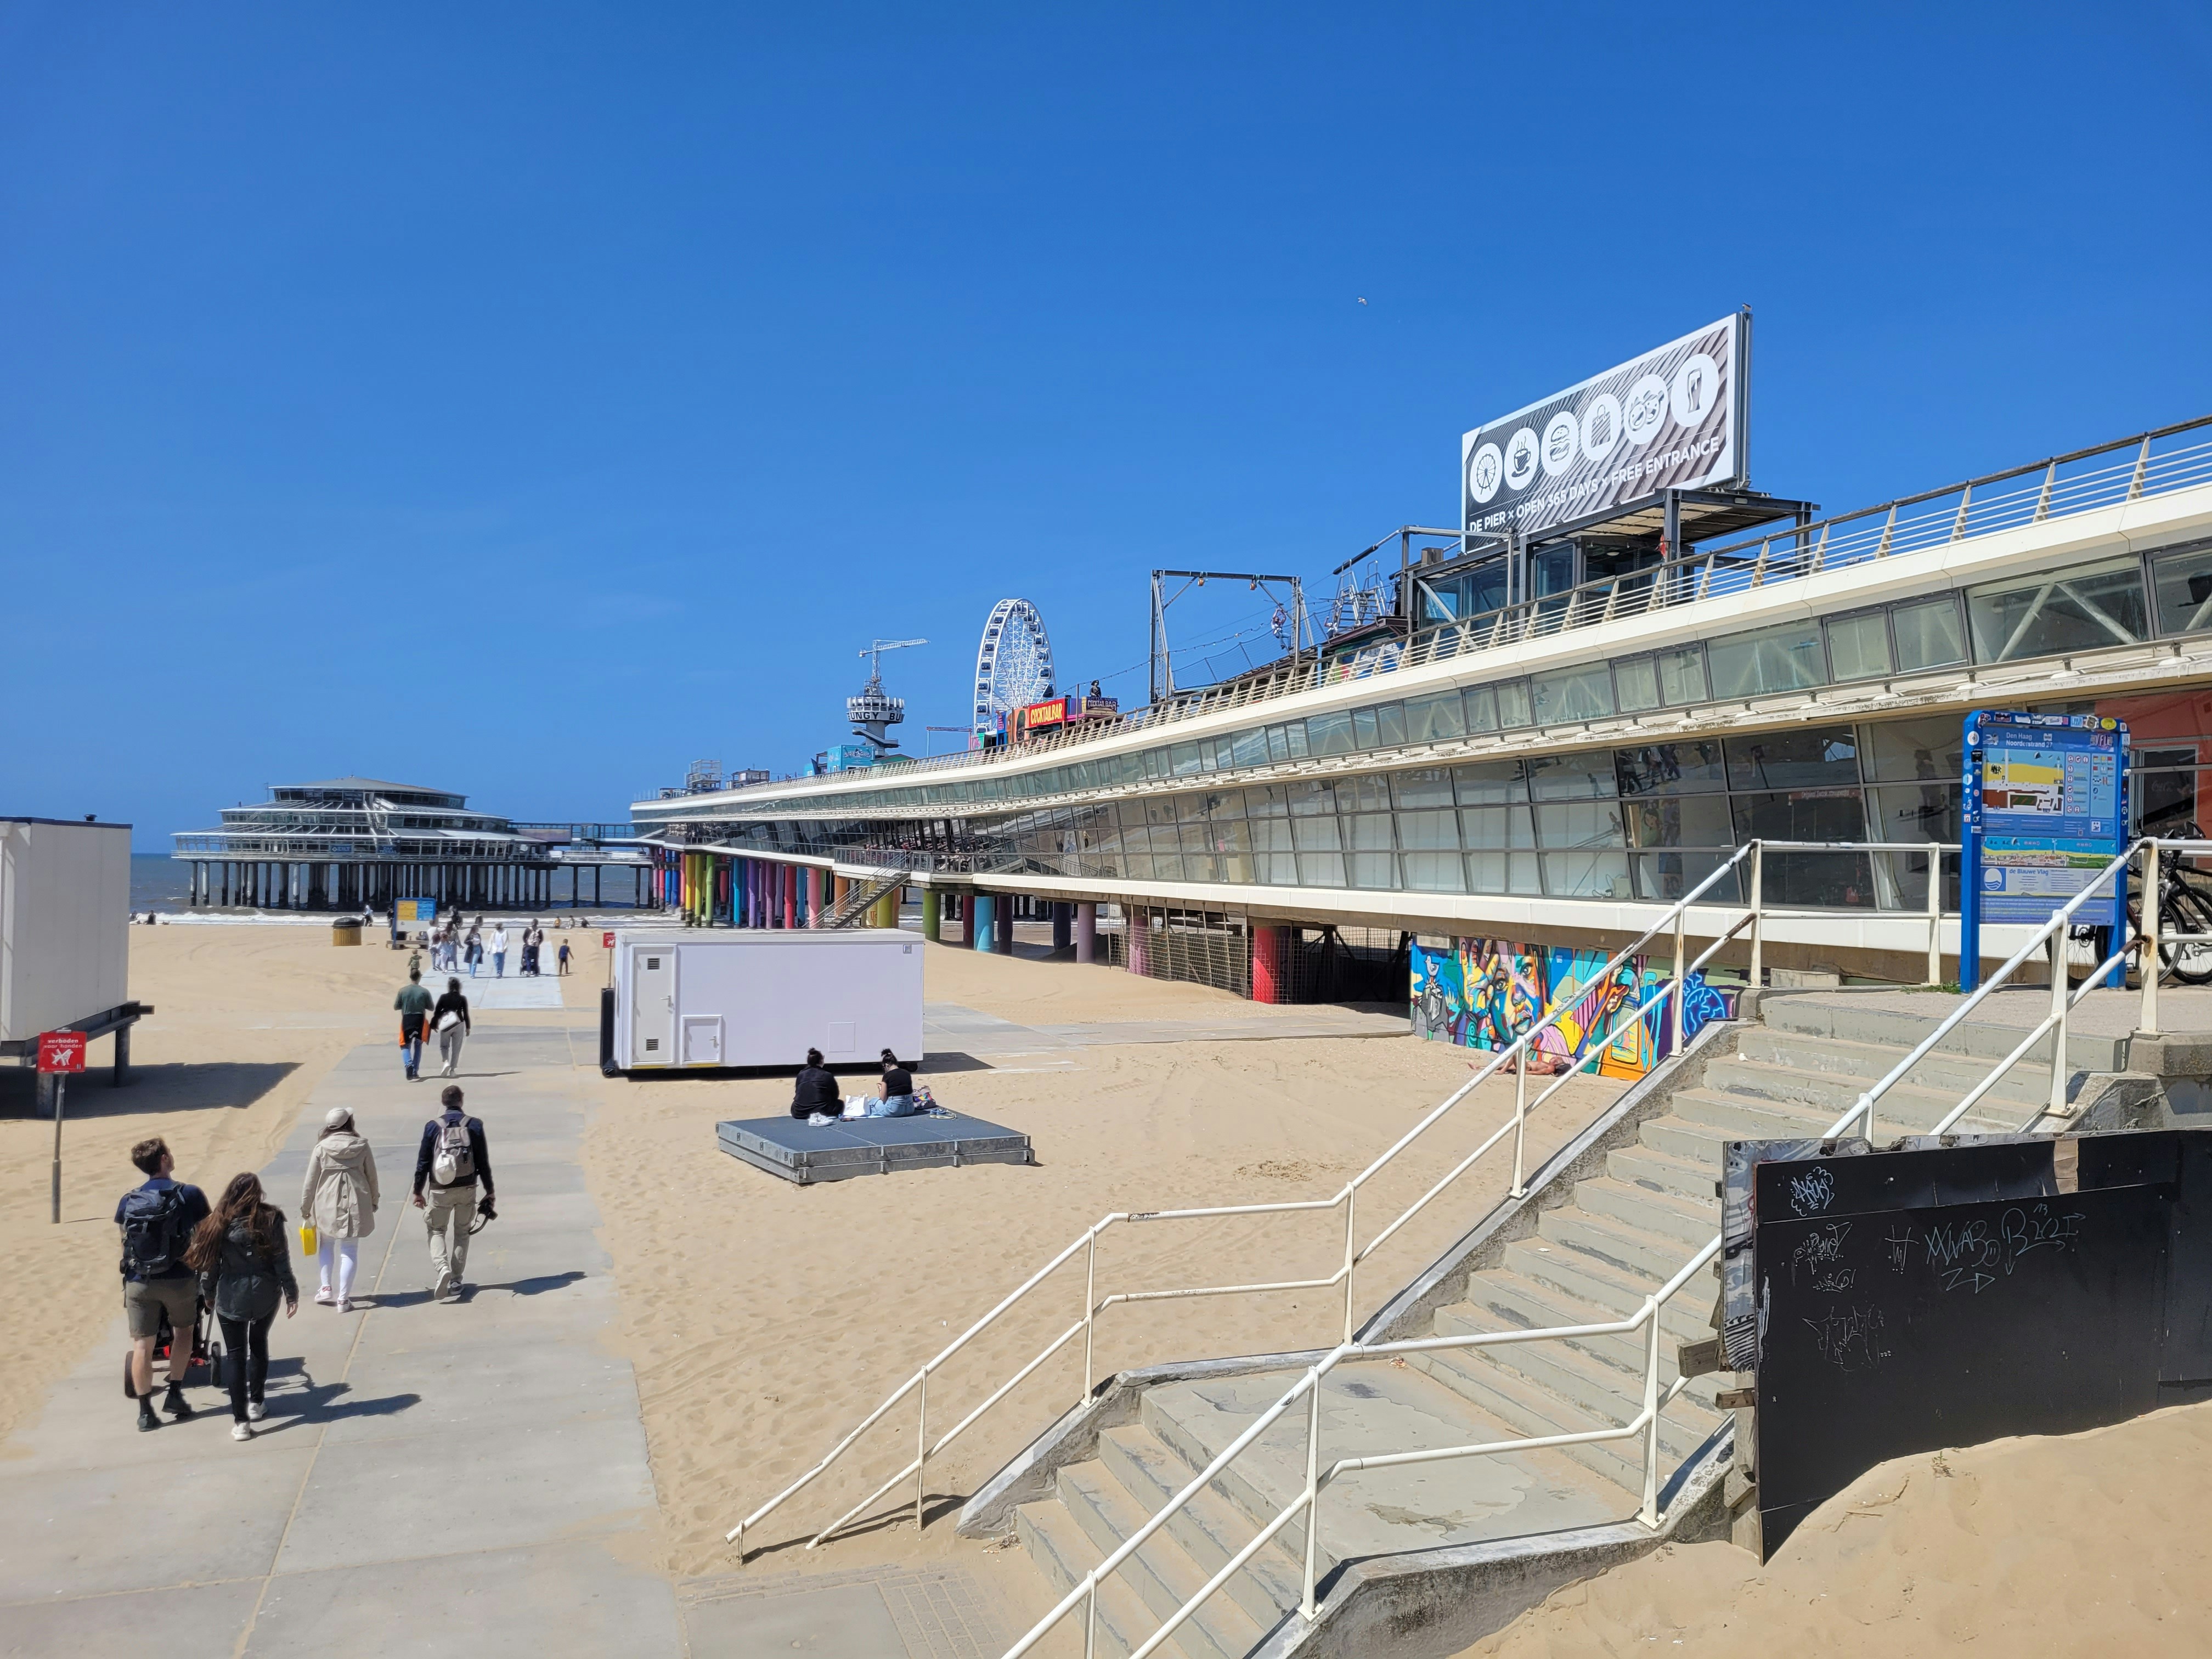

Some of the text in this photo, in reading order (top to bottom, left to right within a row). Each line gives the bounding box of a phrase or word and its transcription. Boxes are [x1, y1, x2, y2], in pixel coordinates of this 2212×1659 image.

[1470, 517, 1482, 532] DE
[1484, 511, 1506, 530] PIER
[1516, 497, 1545, 519] OPEN
[1547, 490, 1566, 509] 365
[1570, 477, 1598, 501] DAYS
[1611, 462, 1643, 486] FREE
[1645, 436, 1720, 475] ENTRANCE
